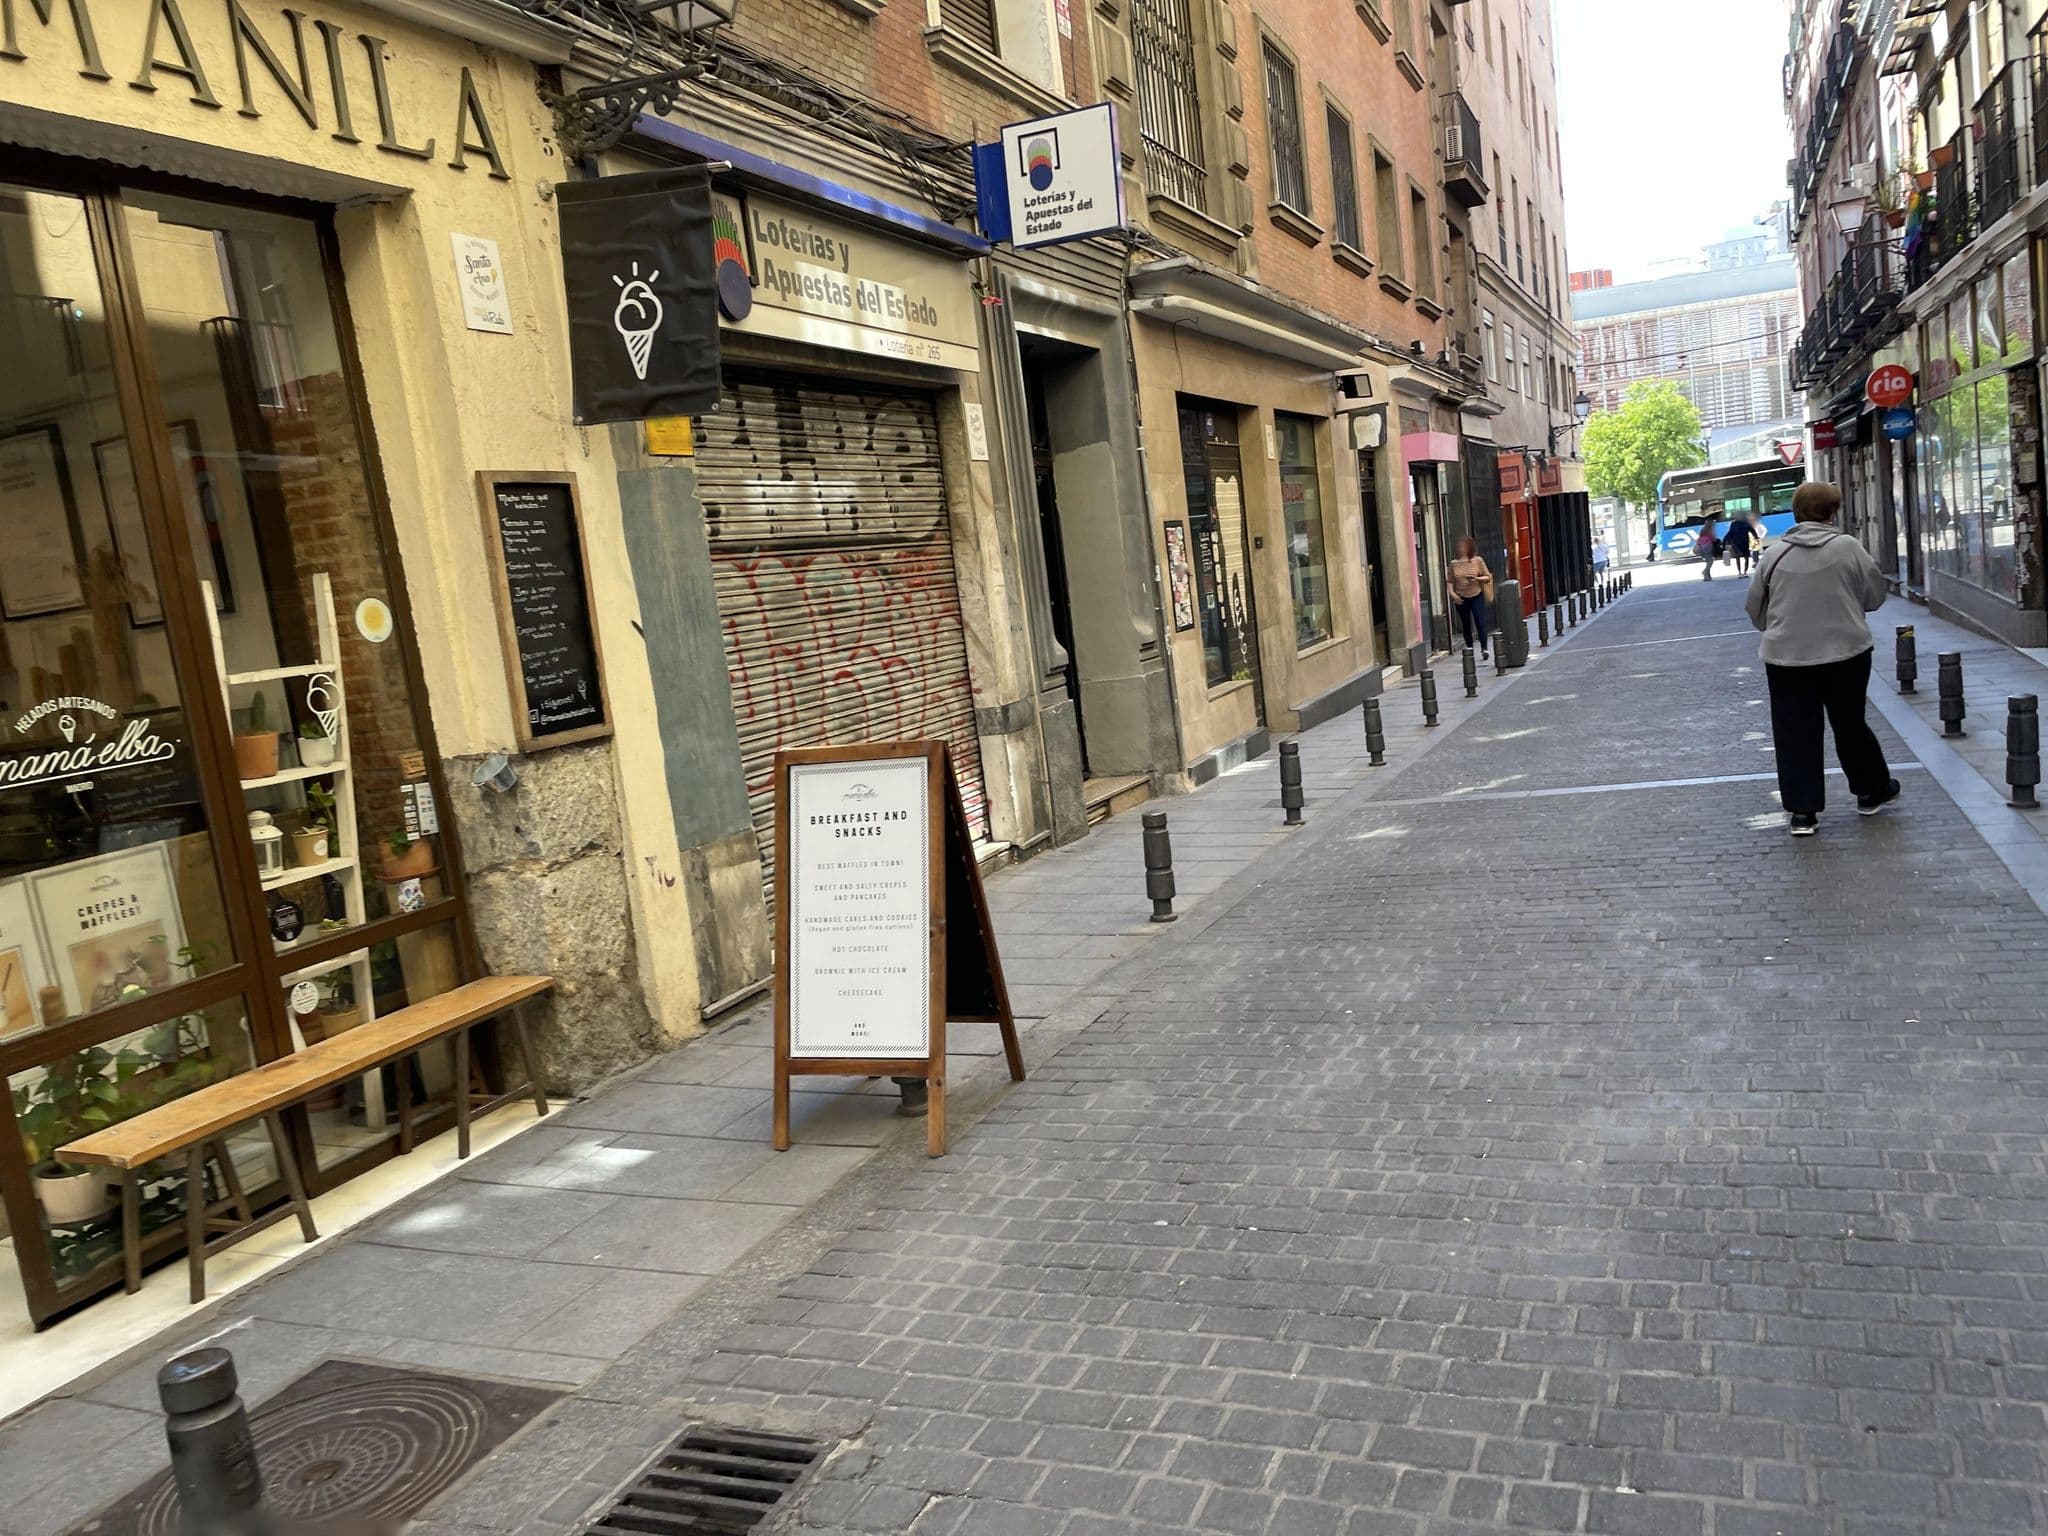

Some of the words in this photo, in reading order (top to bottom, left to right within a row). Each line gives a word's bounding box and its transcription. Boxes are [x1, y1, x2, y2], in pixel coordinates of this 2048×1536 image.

[0, 0, 511, 180] MANILA
[1024, 191, 1066, 208] Loterías
[1069, 190, 1076, 202] y
[1026, 205, 1074, 222] Apuestas
[1077, 198, 1093, 211] del
[1026, 220, 1062, 236] Estado
[753, 209, 835, 262] Loterías
[839, 242, 849, 274] y
[465, 254, 491, 274] Santa
[764, 257, 852, 308] Apuestas
[856, 279, 882, 315] del
[884, 288, 938, 327] Estado
[928, 344, 941, 361] 265
[1873, 371, 1906, 393] ria
[14, 700, 58, 734] HELADOS
[57, 696, 117, 720] ARTESANOS
[98, 718, 172, 765] elba
[810, 812, 878, 825] BREAKFAST
[884, 810, 907, 821] AND
[835, 826, 881, 838] SNACKS
[817, 862, 835, 870] BEST
[838, 861, 868, 869] WAFFLES
[870, 860, 878, 868] IN
[856, 882, 877, 890] SALTY
[880, 881, 907, 889] CREPES
[78, 897, 125, 917] CREPES
[834, 894, 848, 902] AND
[80, 906, 142, 930] WAFFLES!
[805, 916, 841, 924] HANDMADE
[870, 914, 883, 922] AND
[886, 913, 917, 921] COOKIES
[846, 924, 867, 932] gluten
[848, 945, 888, 953] CHOCOLATE
